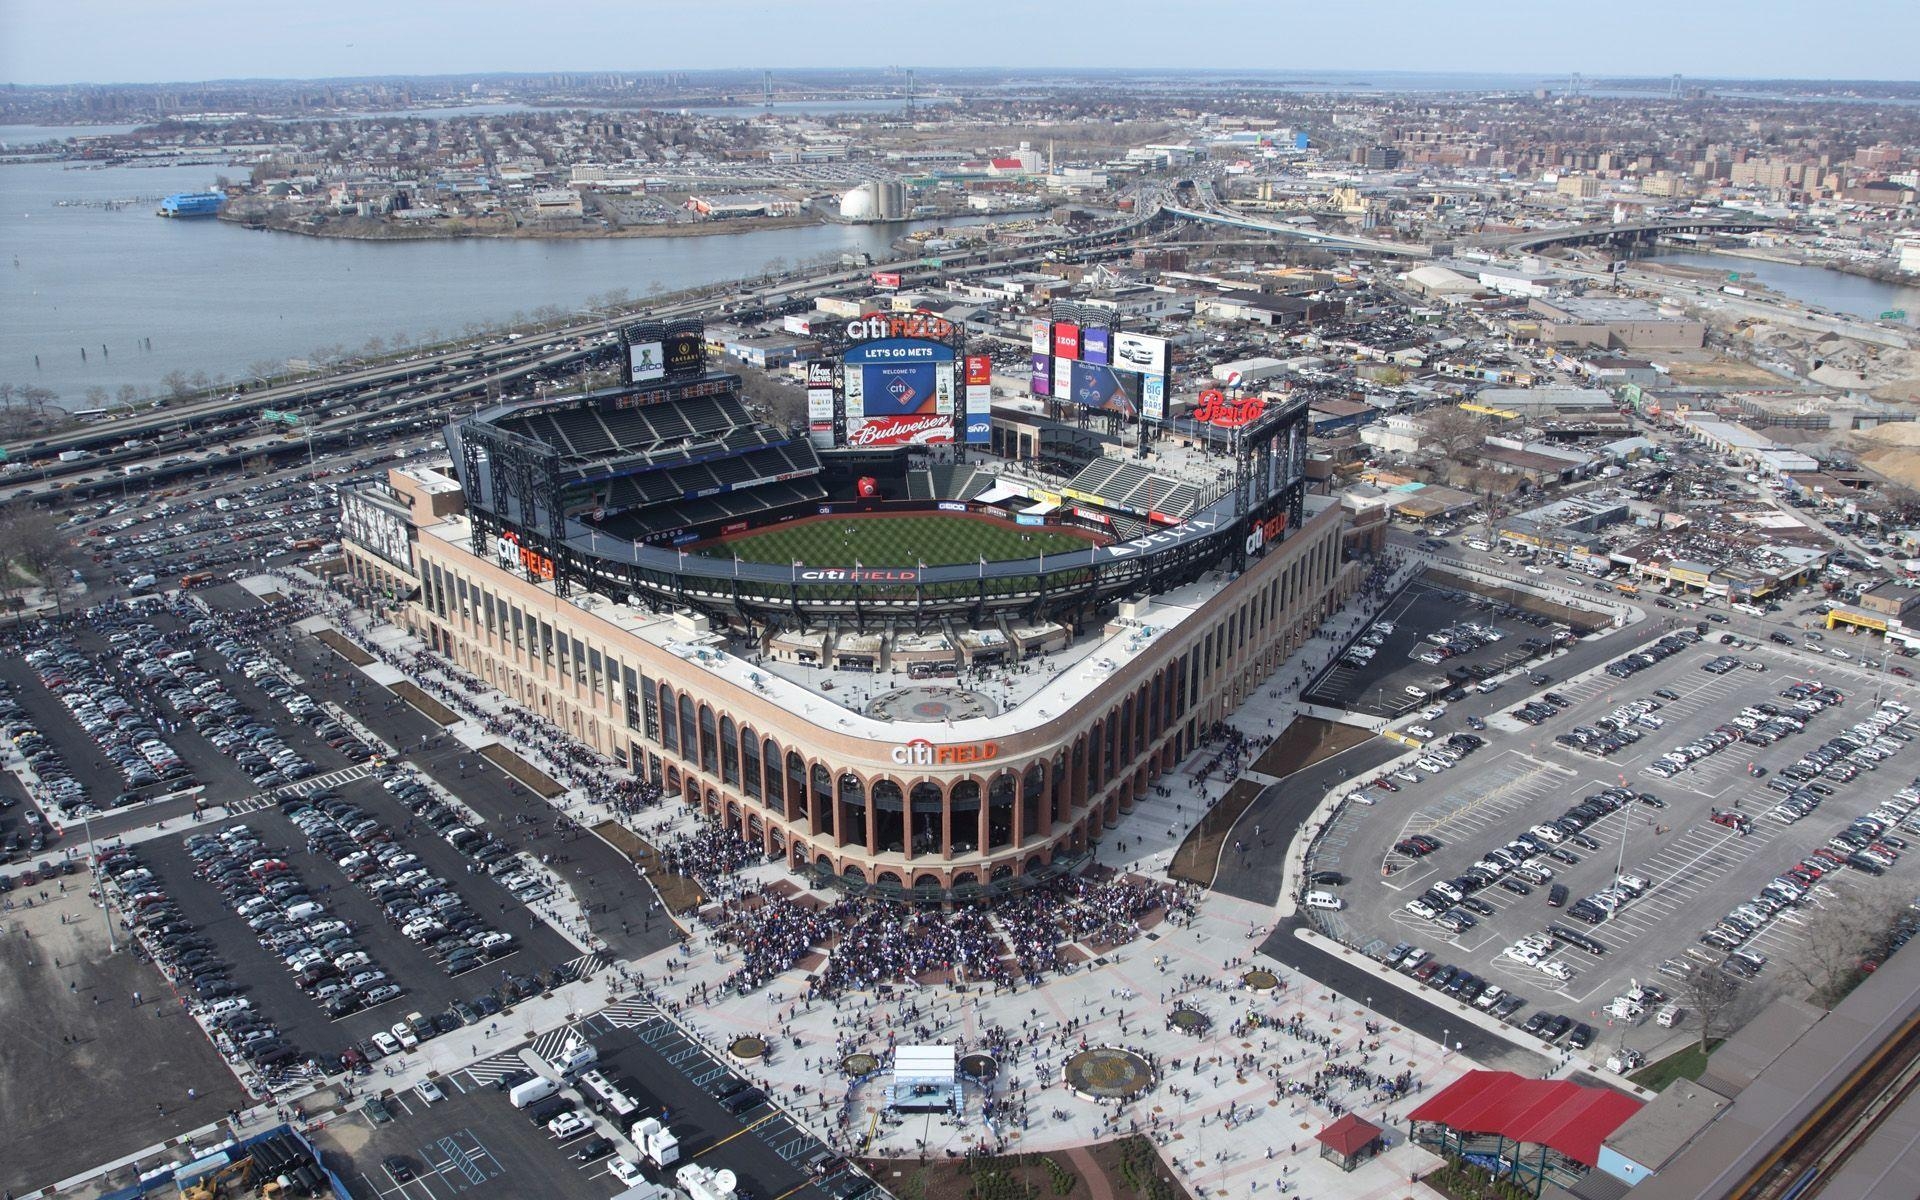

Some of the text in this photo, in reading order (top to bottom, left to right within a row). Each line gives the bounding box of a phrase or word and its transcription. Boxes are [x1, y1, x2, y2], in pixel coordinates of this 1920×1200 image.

[848, 317, 951, 338] citi FIELD
[1056, 336, 1077, 347] IZOD
[865, 348, 933, 358] LET'S GO METS
[632, 363, 663, 373] GEICO
[817, 368, 831, 376] FOX
[890, 383, 906, 393] citi
[1146, 384, 1161, 396] BIG
[854, 415, 949, 445] Budweiser
[967, 424, 988, 433] SNY
[819, 506, 832, 514] citi
[938, 502, 966, 511] GEICO
[1129, 519, 1216, 548] DELTA
[520, 547, 556, 580] FIELD
[802, 570, 916, 581] citi FIELD
[892, 741, 998, 765] citi FIELD
